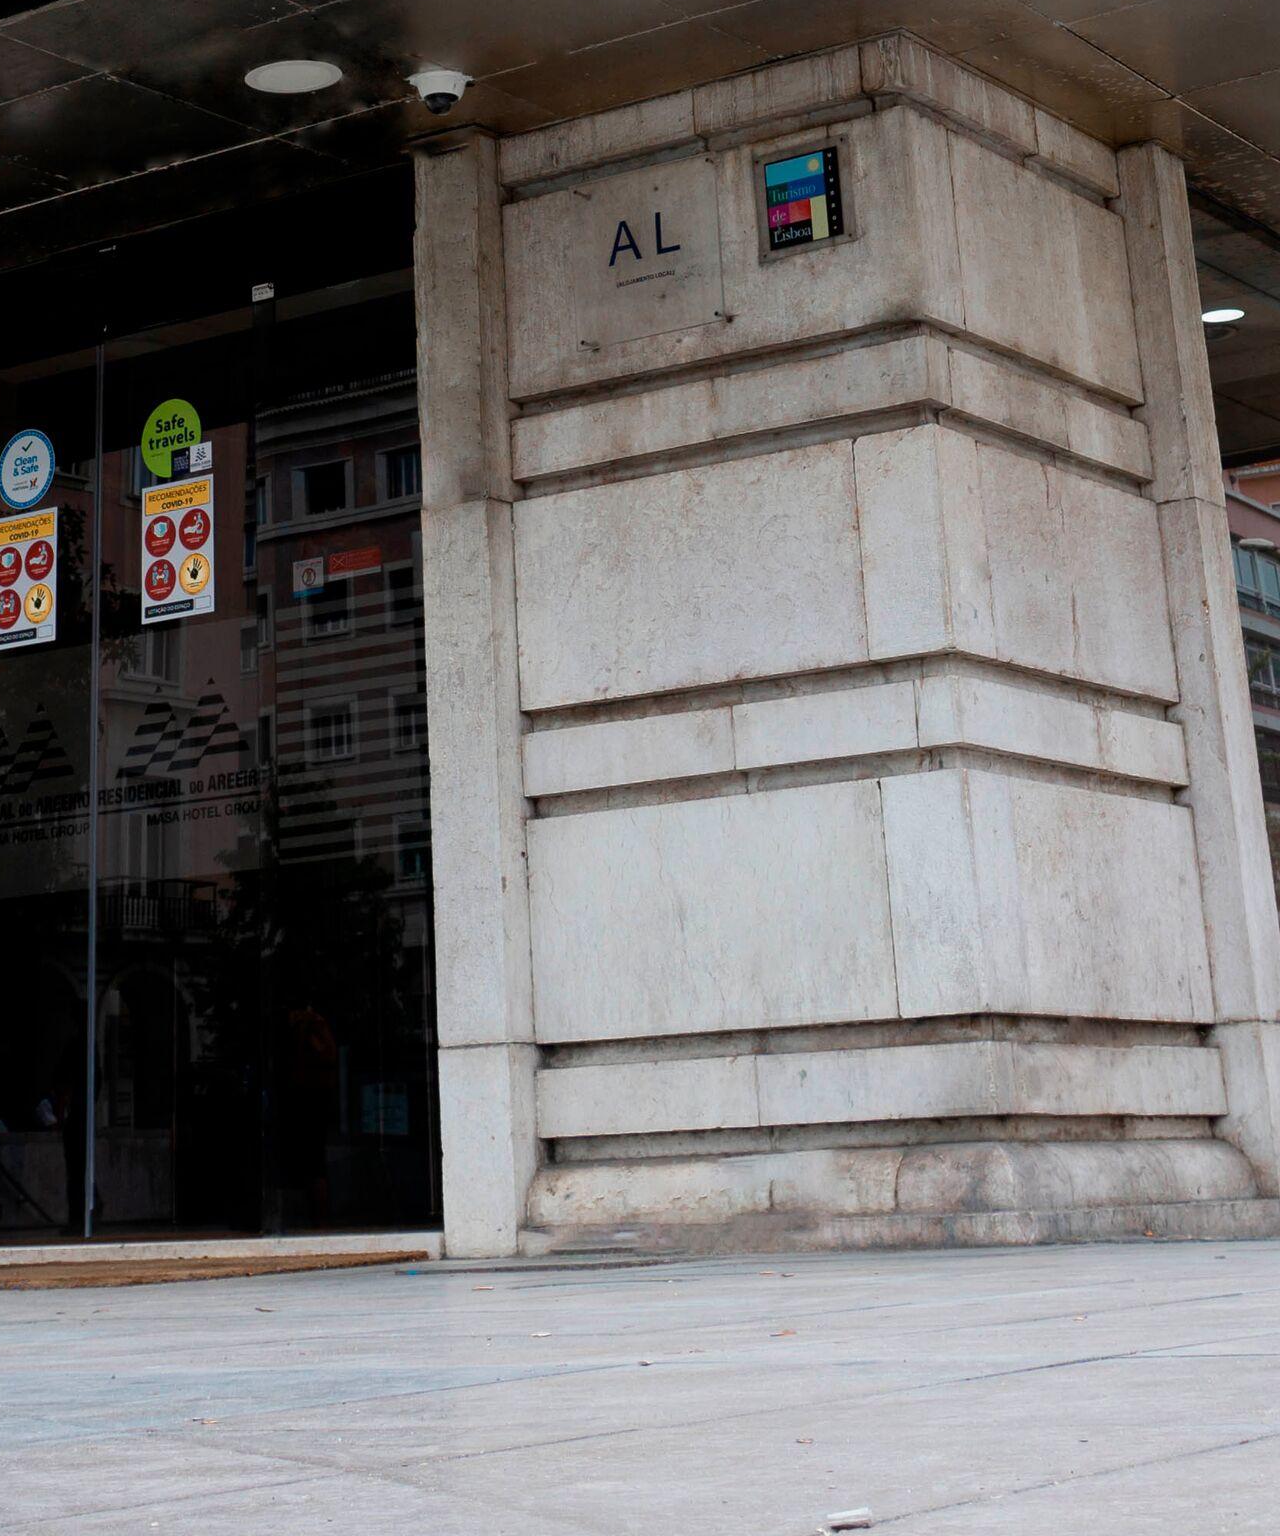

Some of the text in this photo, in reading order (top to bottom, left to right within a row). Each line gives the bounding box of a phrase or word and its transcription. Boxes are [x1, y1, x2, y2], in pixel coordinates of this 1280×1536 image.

[772, 183, 816, 202] Turismo
[772, 209, 787, 223] de
[774, 225, 812, 244] Lisboa
[155, 414, 185, 434] Safe
[148, 427, 195, 450] travels
[14, 455, 38, 467] Clean
[21, 464, 39, 475] Safe
[161, 497, 193, 510] COVID-19
[9, 529, 39, 542] COVID-19
[97, 779, 182, 806] RESIDENCIAL
[208, 767, 266, 793] AREEIR
[147, 811, 180, 827] MASA
[183, 805, 221, 821] HOTEL
